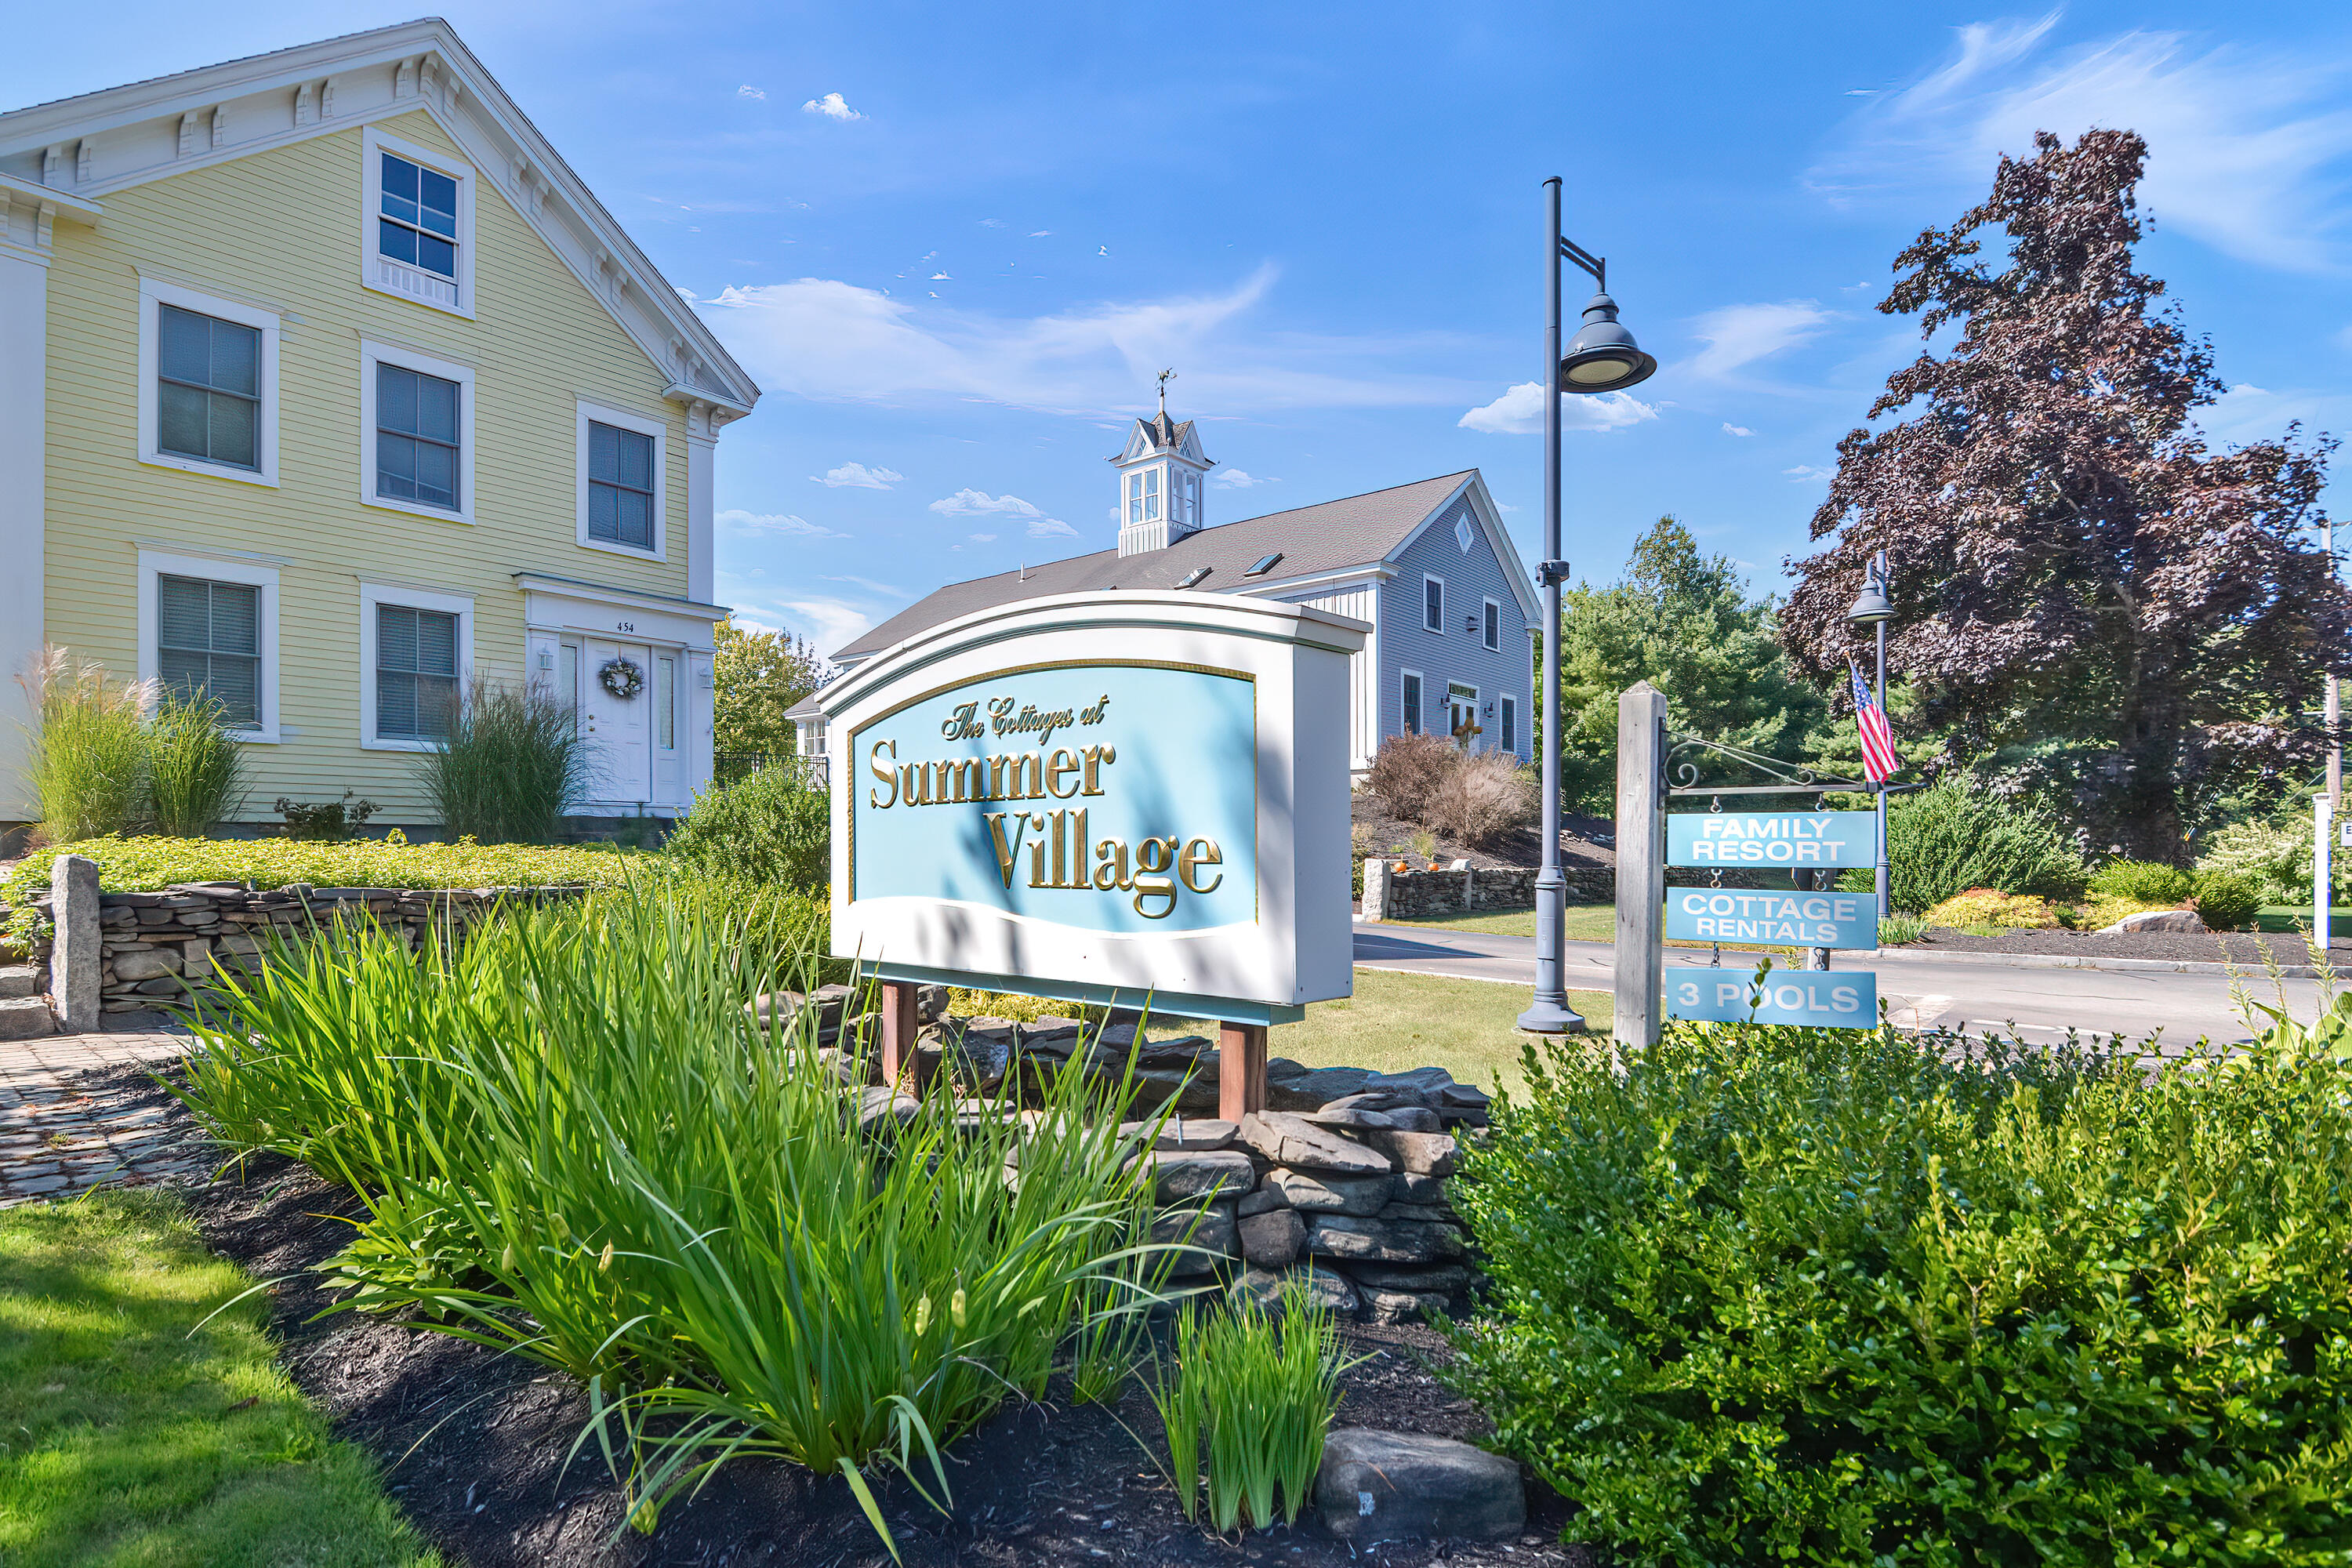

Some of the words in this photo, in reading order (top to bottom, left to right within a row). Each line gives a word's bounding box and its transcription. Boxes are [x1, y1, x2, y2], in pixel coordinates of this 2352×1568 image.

[617, 622, 633, 633] 454
[941, 700, 985, 741] The
[987, 696, 1074, 746] Cottages
[1080, 694, 1109, 725] at
[870, 739, 1116, 809] Summer
[1702, 818, 1833, 839] FAMILY
[983, 807, 1223, 919] Village
[1692, 840, 1846, 862] RESORT
[1682, 893, 1857, 922] COTTAGE
[1696, 917, 1838, 942] RENTALS
[1678, 982, 1700, 1007] 3
[1715, 983, 1860, 1013] POOLS
